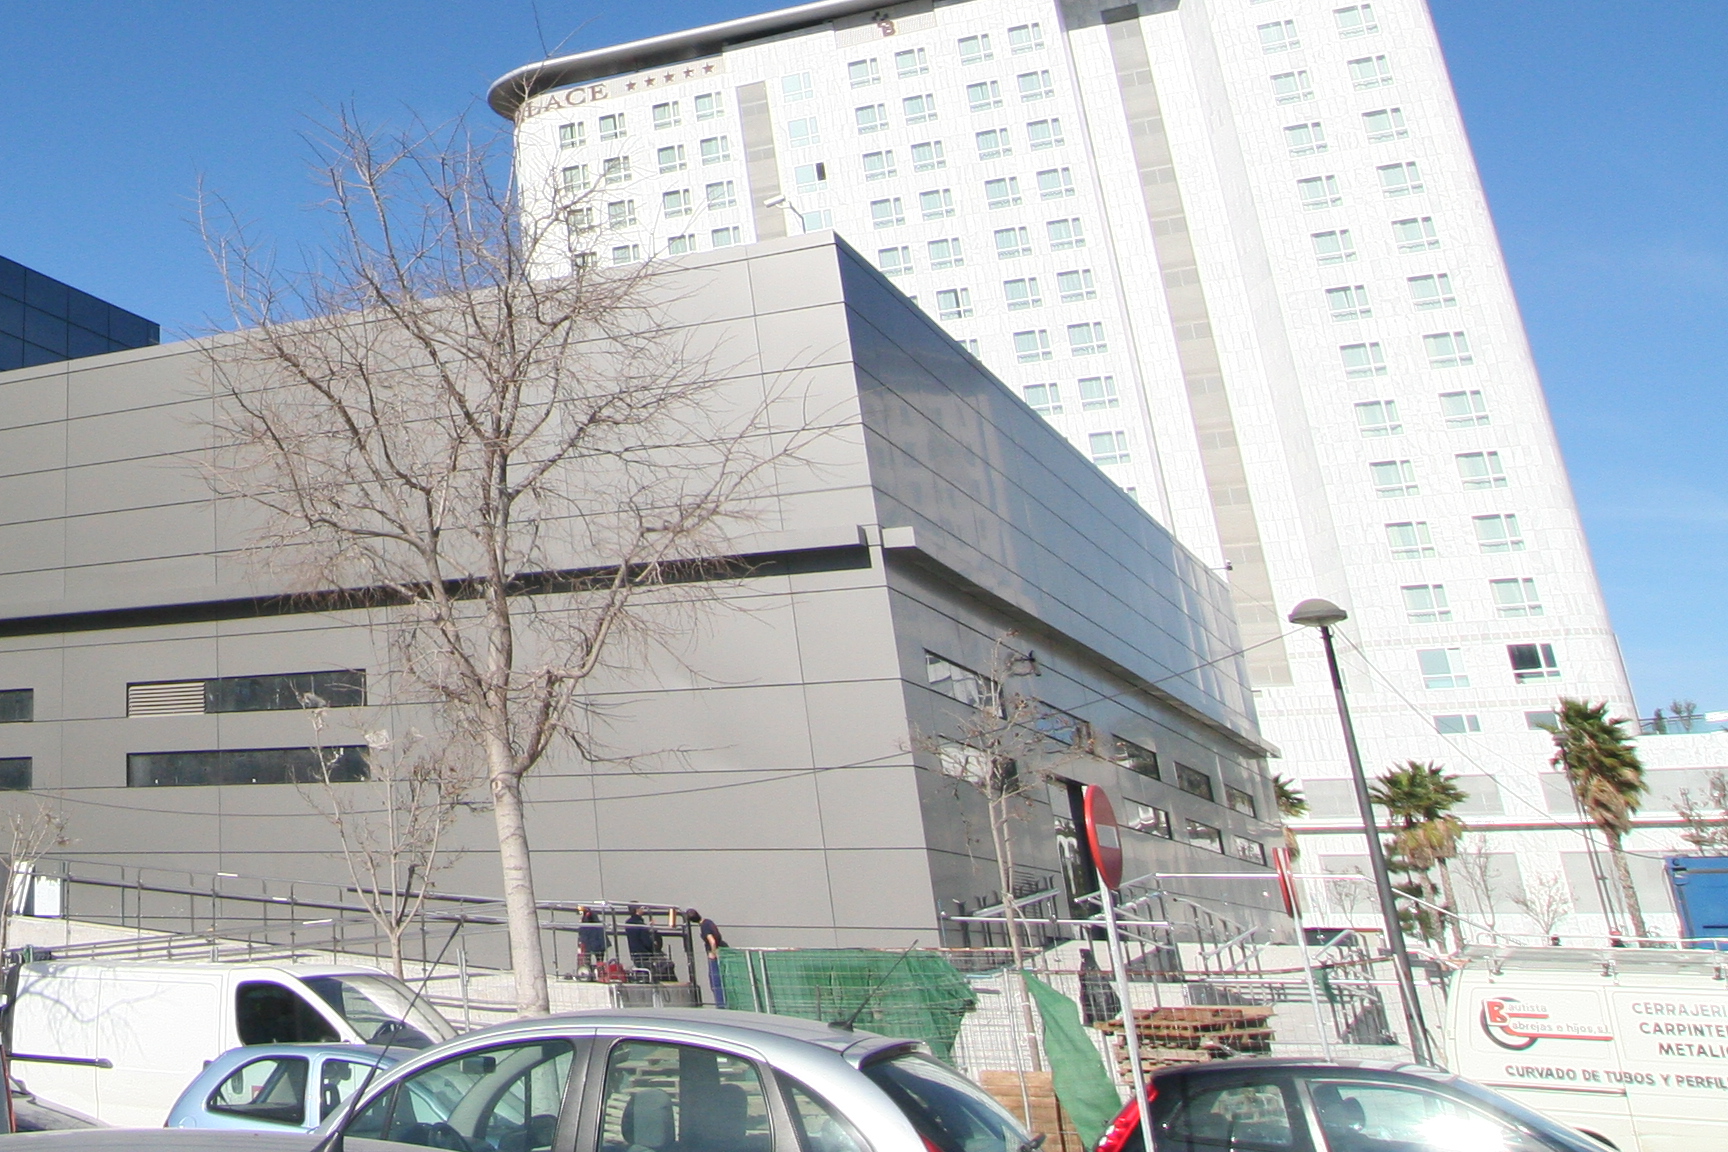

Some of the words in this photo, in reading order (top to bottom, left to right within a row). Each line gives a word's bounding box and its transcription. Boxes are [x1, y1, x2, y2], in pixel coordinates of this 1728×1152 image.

[1632, 1002, 1728, 1018] CERRAJERI
[1639, 1022, 1728, 1038] CARPINTE
[1658, 1042, 1728, 1058] METALI
[1505, 1064, 1576, 1081] CURVADO
[1581, 1069, 1601, 1083] DE
[1603, 1070, 1656, 1086] TUBOS
[1659, 1073, 1672, 1087] Y
[1674, 1074, 1728, 1090] PERFIL
